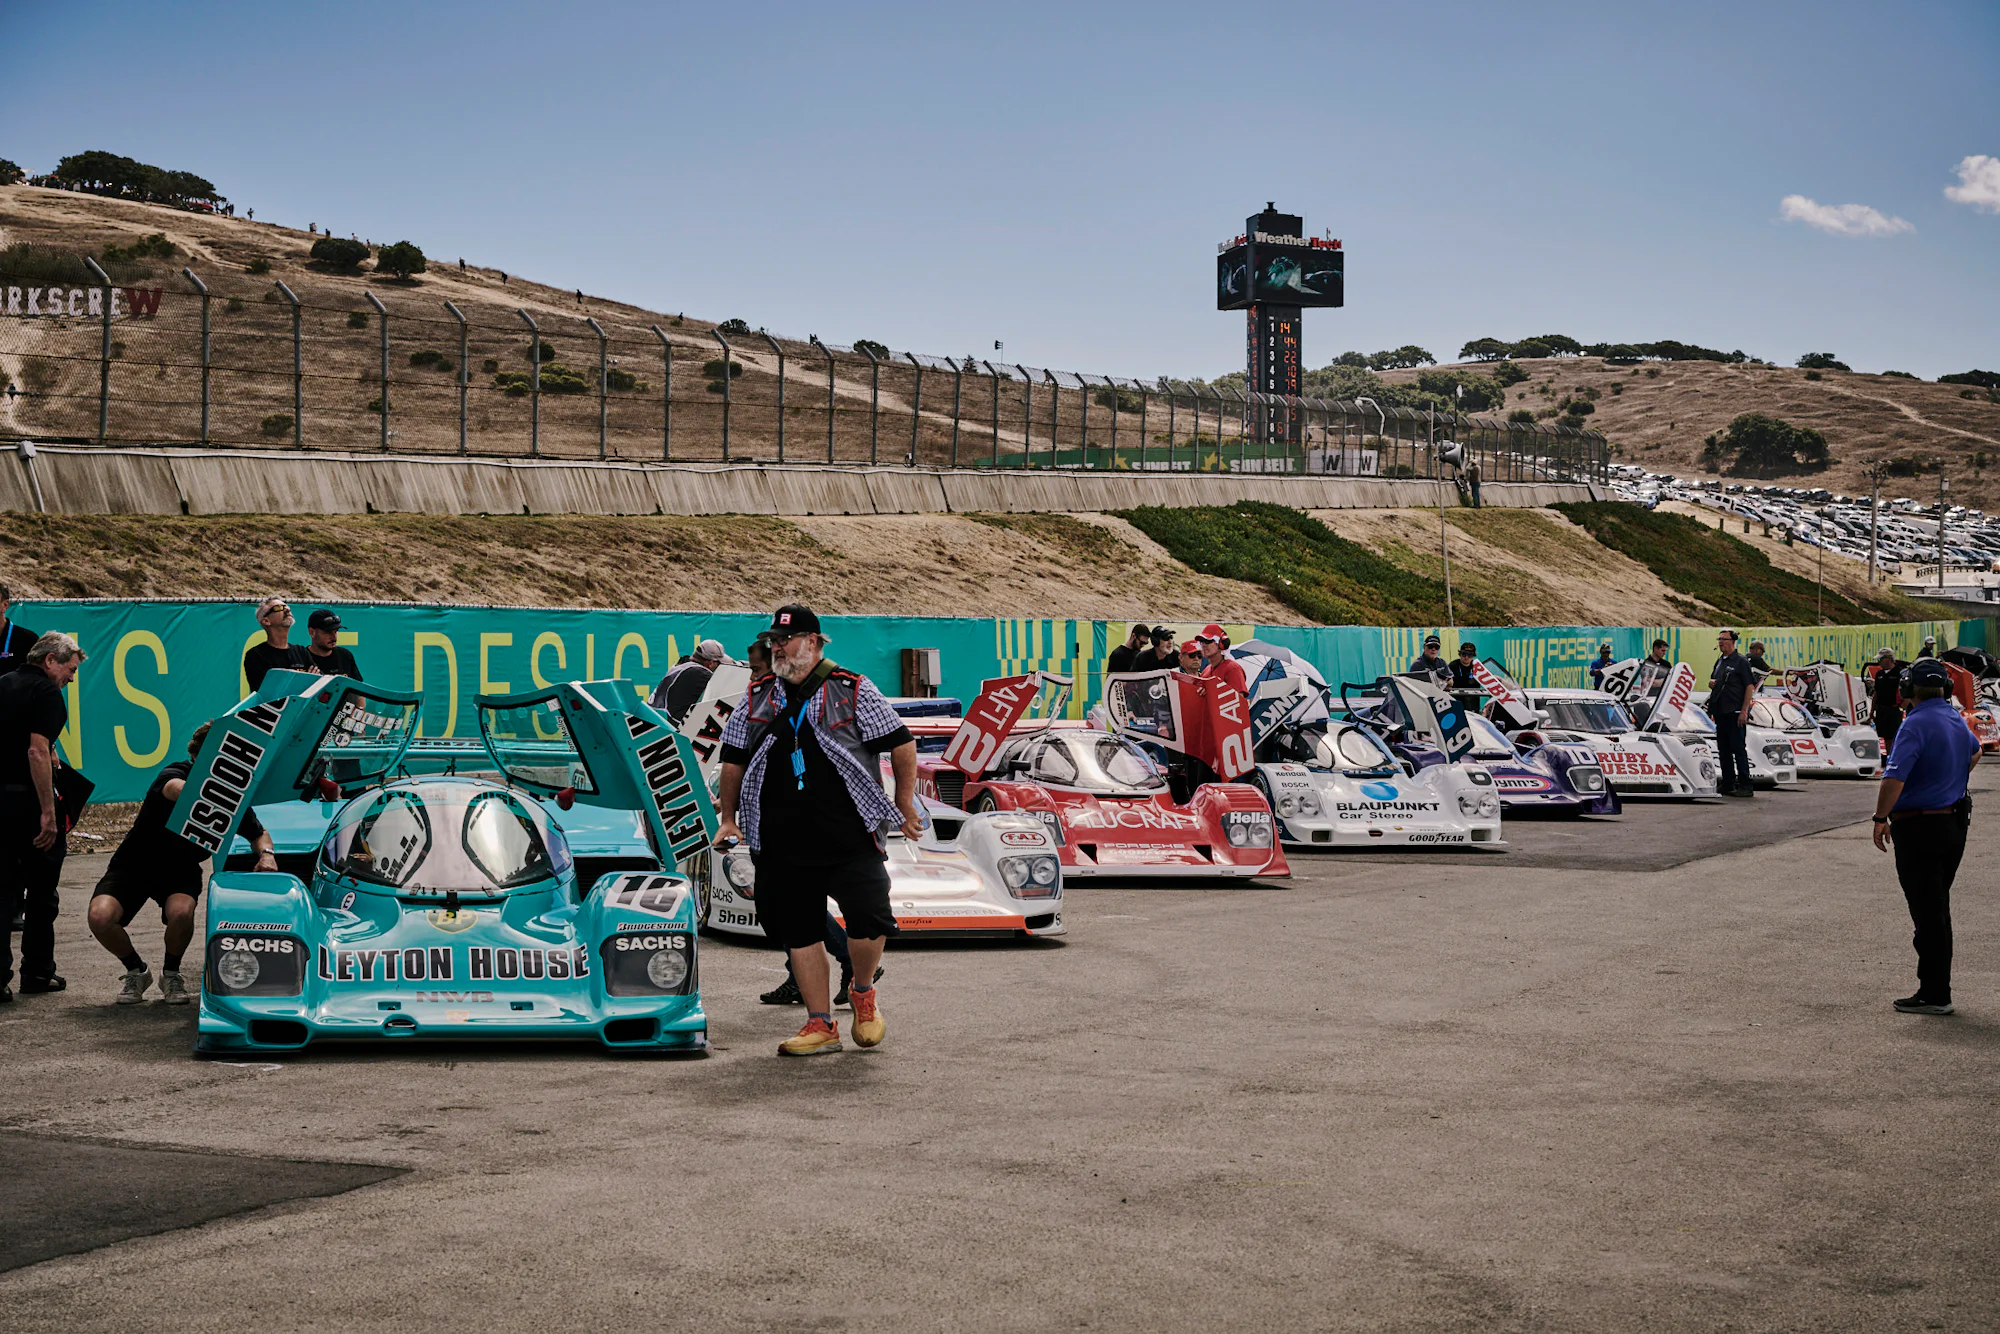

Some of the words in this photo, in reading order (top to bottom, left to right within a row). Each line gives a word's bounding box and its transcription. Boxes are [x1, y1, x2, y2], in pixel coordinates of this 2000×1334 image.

[1254, 230, 1342, 249] WeatherTech
[0, 286, 164, 316] RKSCREW
[1270, 322, 1275, 332] 1
[1280, 322, 1290, 334] 14
[1269, 336, 1275, 346] 2
[1283, 337, 1297, 348] 44
[1269, 350, 1275, 361] 3
[1283, 350, 1297, 364] 22
[1269, 365, 1275, 375] 4
[1269, 379, 1275, 389] 5
[1285, 379, 1297, 390] 79
[1270, 408, 1275, 418] 7
[1269, 422, 1275, 432] 8
[414, 631, 701, 739] DESIG
[1473, 661, 1517, 705] RUBY
[1668, 664, 1697, 713] RUBY
[691, 699, 735, 764] FAT
[944, 720, 997, 774] 2
[1222, 727, 1255, 778] 2
[1567, 749, 1597, 765] 10
[1596, 752, 1649, 763] RUBY
[1600, 763, 1678, 776] UESDAY
[180, 730, 265, 854] HOUSE
[636, 733, 712, 863] LEYTON
[1336, 802, 1440, 812] BLAUPUNKT
[1035, 811, 1055, 824] lla
[1069, 811, 1201, 830] ALUCRAFT
[1229, 811, 1271, 824] Hella
[1339, 812, 1363, 820] Car
[1369, 811, 1413, 820] Stereo
[616, 875, 685, 913] 16
[712, 886, 733, 903] SACHS
[217, 921, 292, 931] BRIDGESTONE
[436, 911, 473, 926] BP
[616, 922, 689, 931] BRIDGESTONE
[220, 936, 294, 953] SACHS
[615, 935, 686, 951] SACHS
[318, 942, 453, 982] LEYTON
[468, 942, 591, 981] HOUSE
